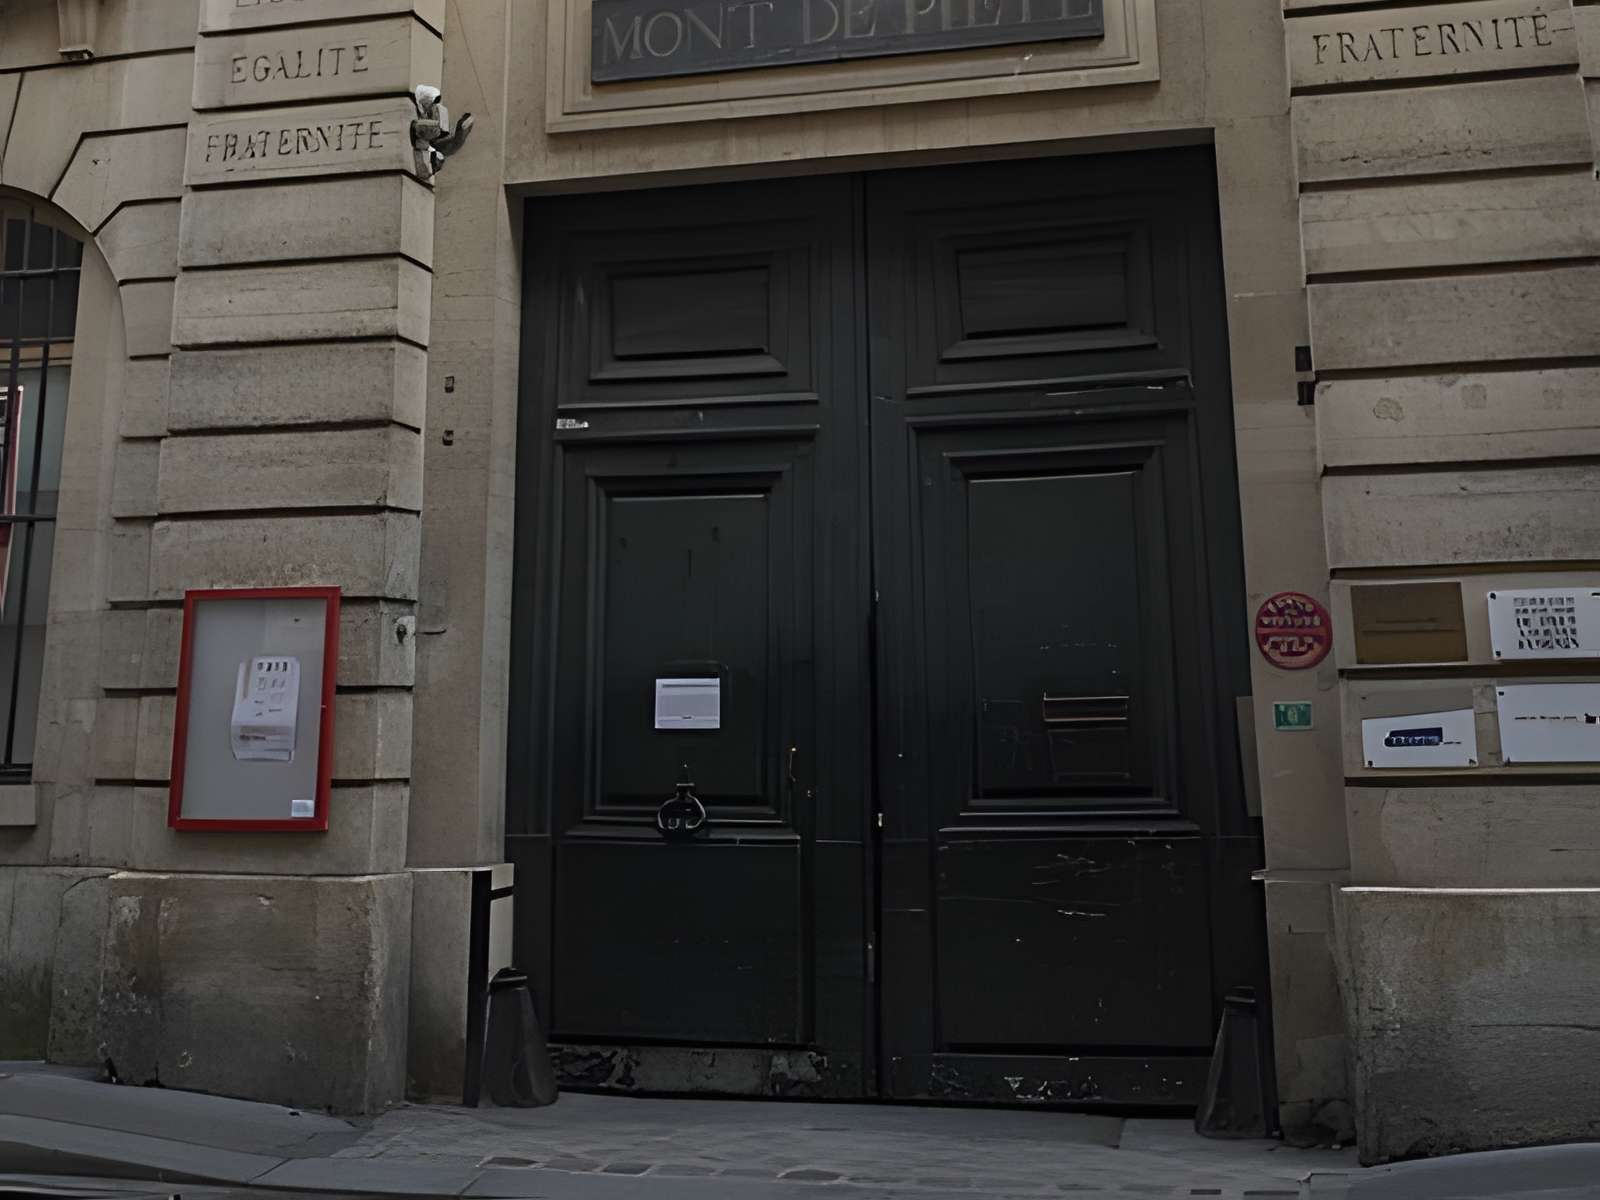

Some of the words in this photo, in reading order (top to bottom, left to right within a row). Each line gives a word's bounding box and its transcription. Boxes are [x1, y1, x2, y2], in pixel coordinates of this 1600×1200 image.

[602, 0, 773, 65] MONT
[231, 45, 369, 84] EGALITE
[205, 120, 384, 163] FRATERNITE
